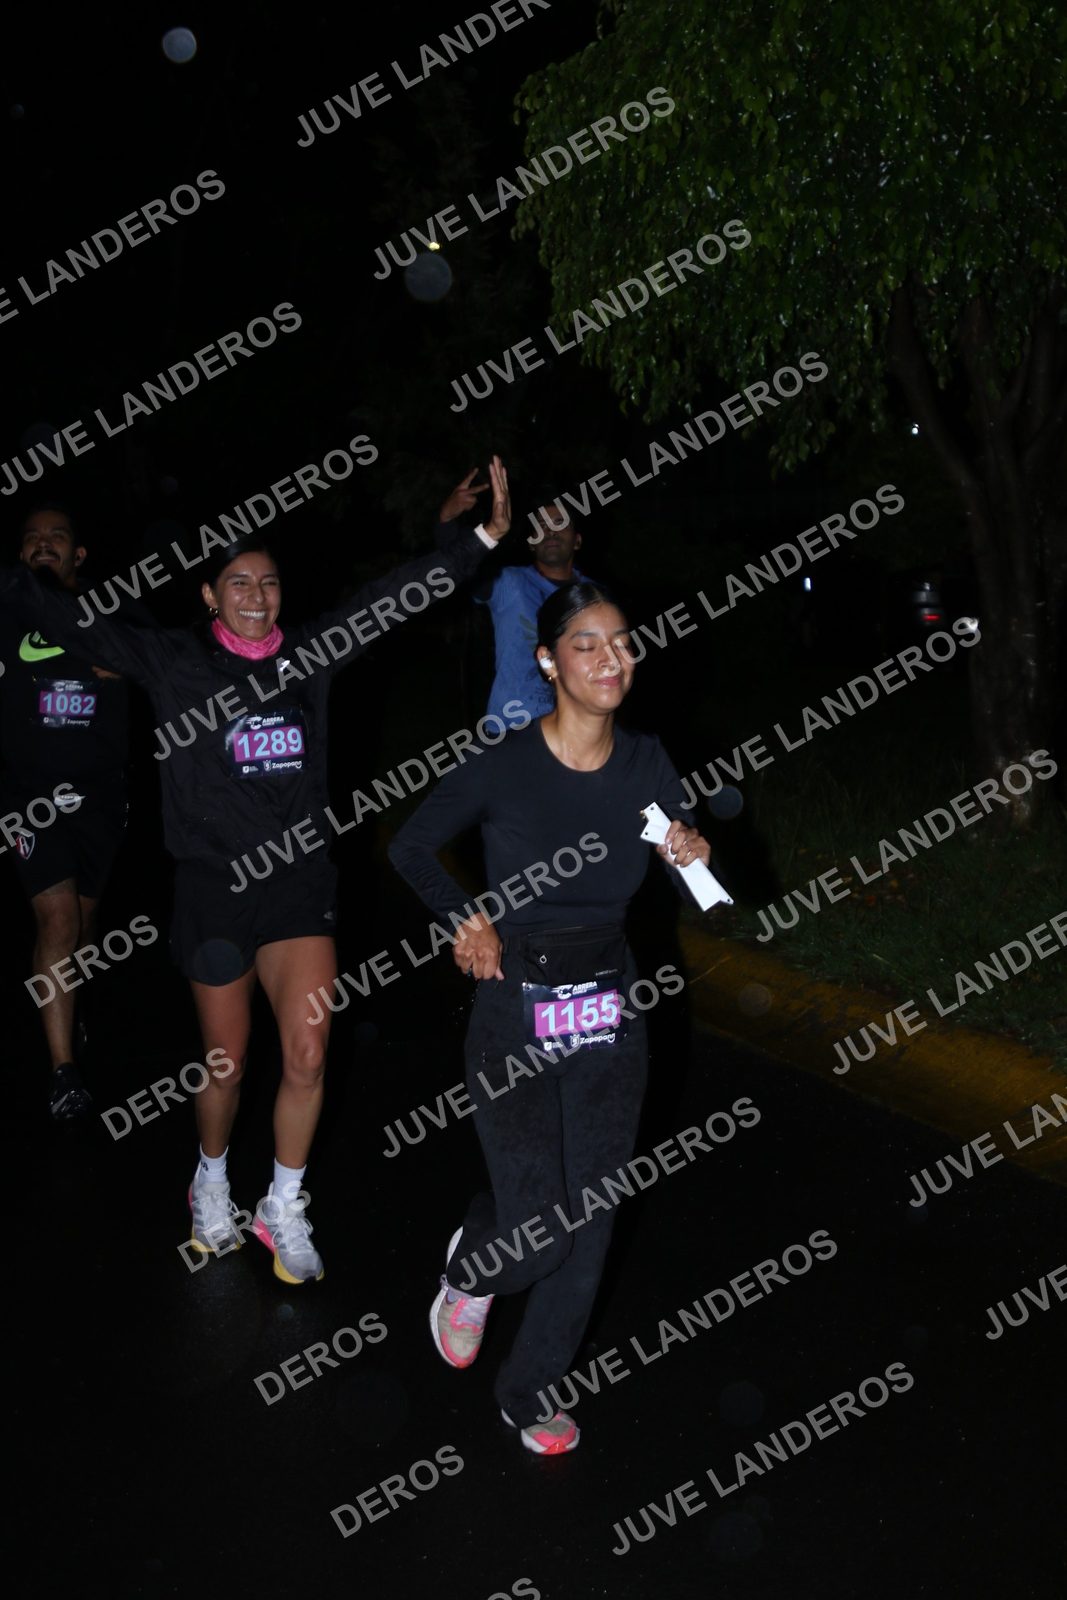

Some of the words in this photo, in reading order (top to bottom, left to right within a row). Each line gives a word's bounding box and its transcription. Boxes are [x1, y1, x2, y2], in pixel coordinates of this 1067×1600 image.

[42, 692, 96, 715] 1082
[238, 727, 303, 759] 1289
[541, 992, 618, 1034] 1155
